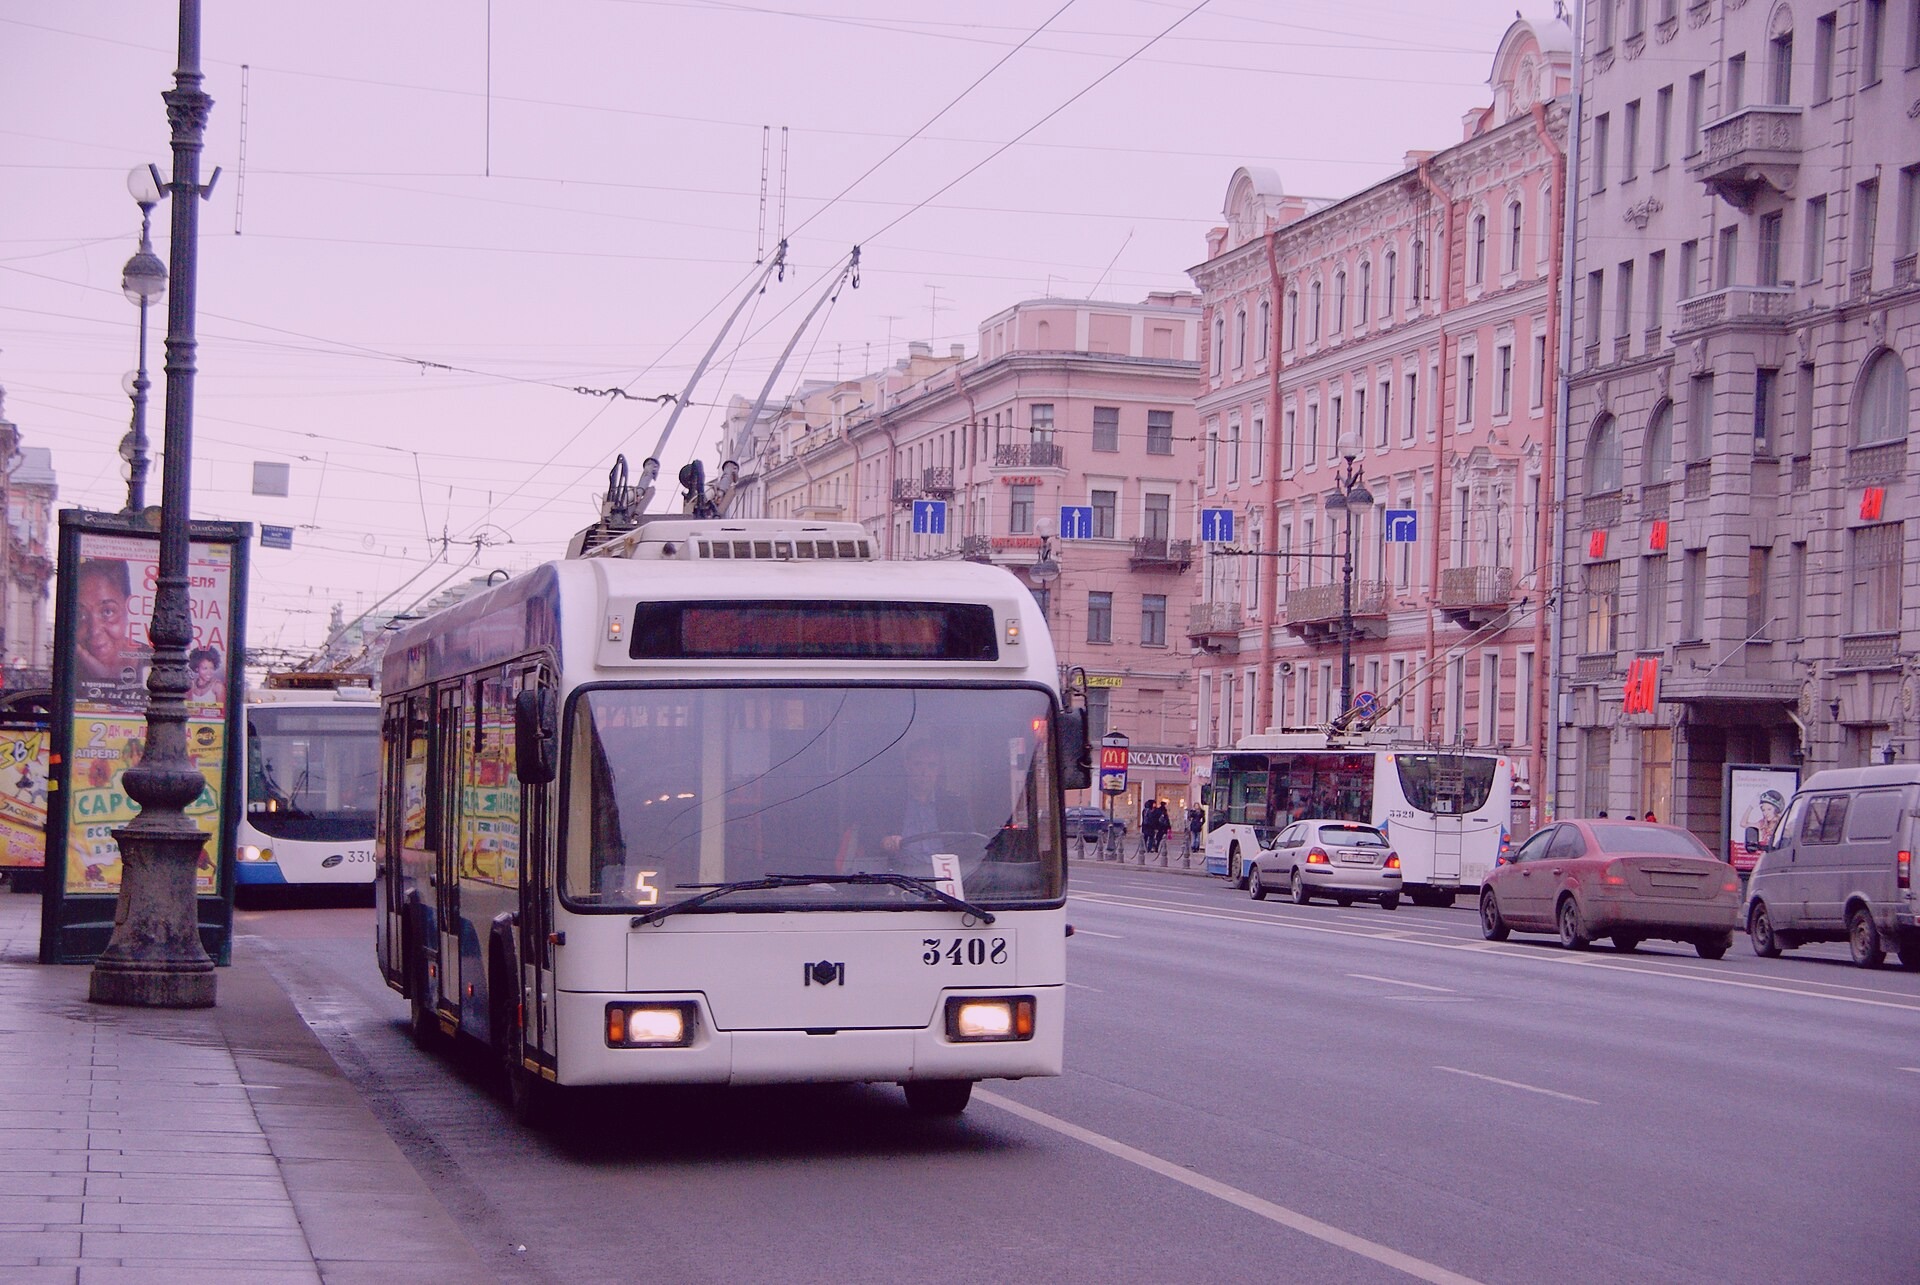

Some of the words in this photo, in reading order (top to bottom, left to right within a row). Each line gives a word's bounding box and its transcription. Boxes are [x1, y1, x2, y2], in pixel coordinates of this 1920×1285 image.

[1001, 476, 1043, 486] ОТЕЛЬ
[1860, 487, 1885, 520] H&M
[1650, 520, 1668, 550] H&M
[1623, 657, 1658, 714] H&M
[89, 722, 107, 747] 2
[75, 749, 120, 759] АПРЕЛЯ
[942, 863, 952, 879] 5
[636, 871, 658, 905] 5
[922, 937, 1008, 966] 3408
